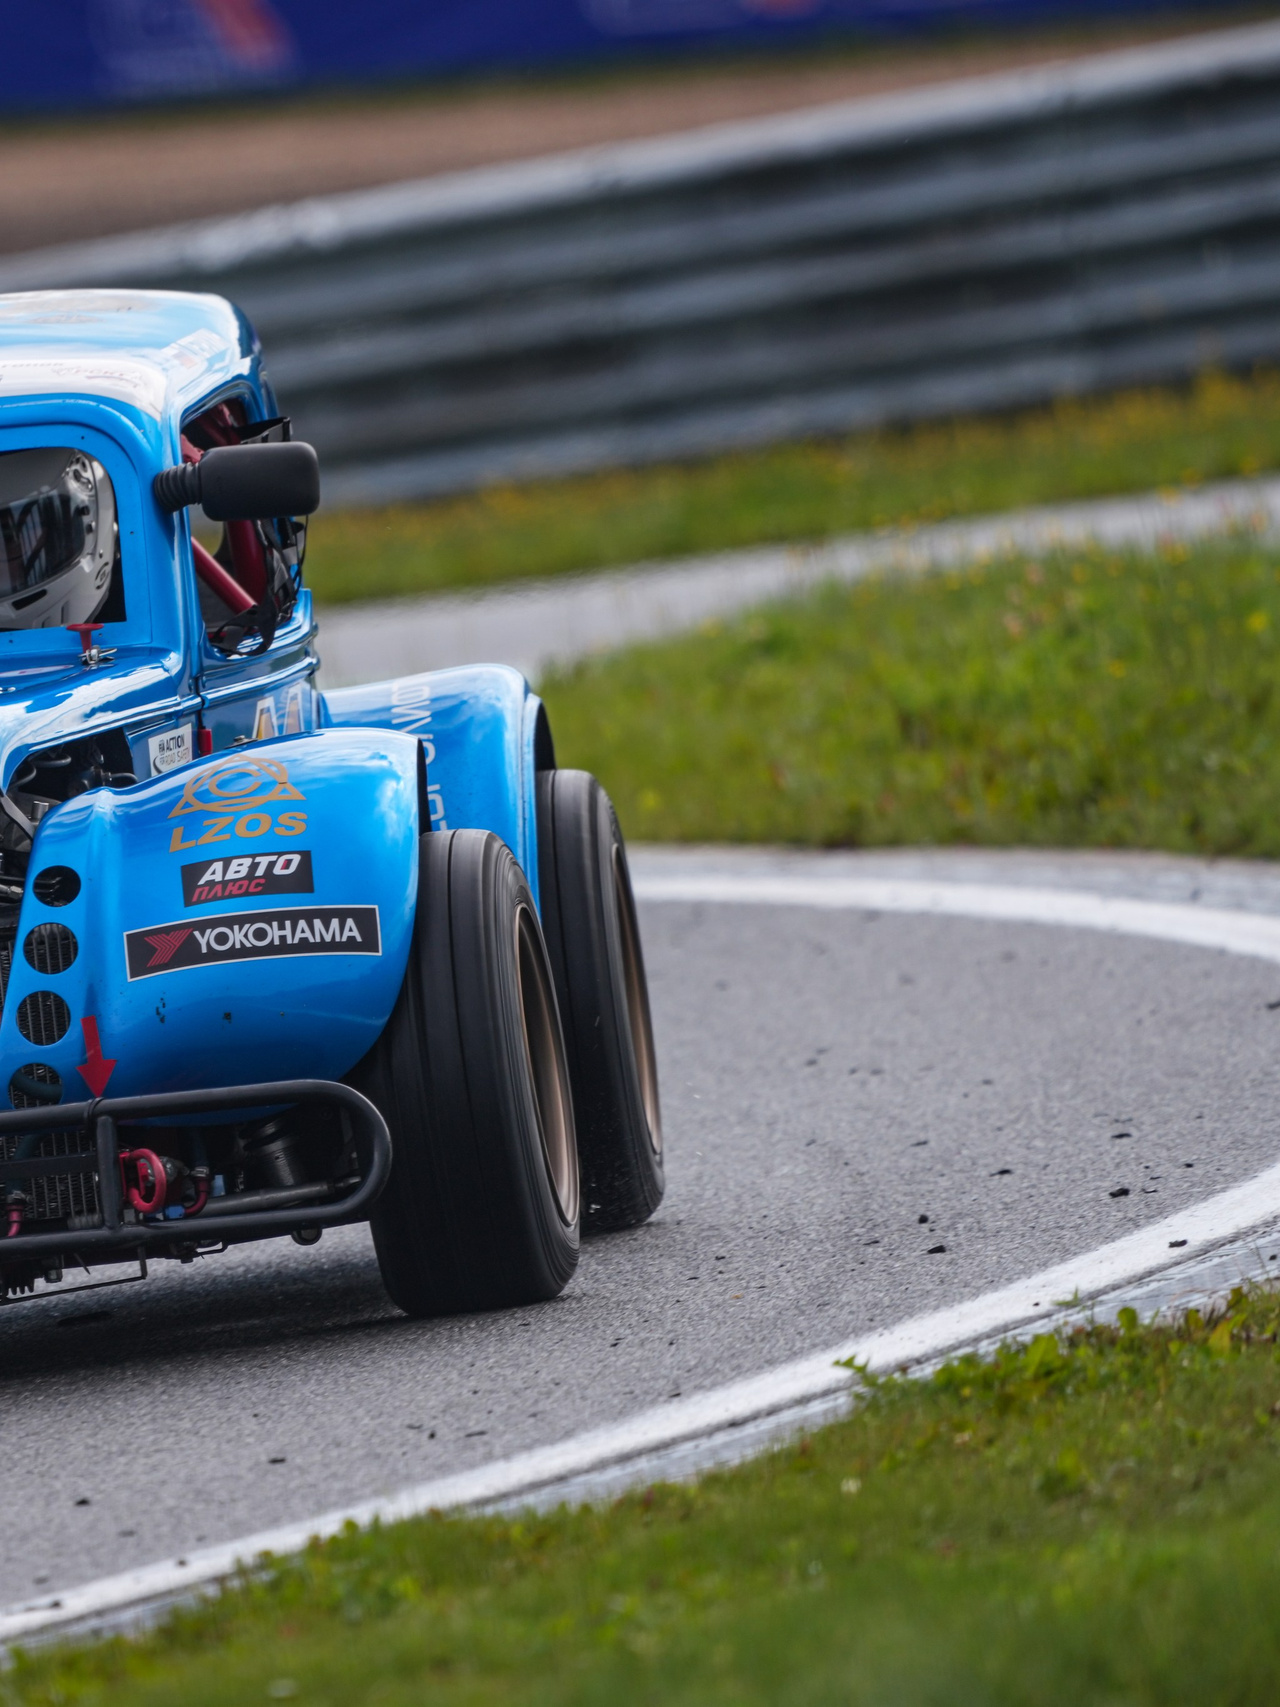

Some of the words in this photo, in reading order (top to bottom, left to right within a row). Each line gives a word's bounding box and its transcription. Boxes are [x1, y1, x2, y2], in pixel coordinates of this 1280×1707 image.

[166, 734, 185, 753] ACTION
[169, 811, 308, 853] LZOS
[197, 853, 301, 885] АВТО
[191, 879, 266, 902] ПЛЮС
[193, 917, 363, 953] YOKOHAMA
